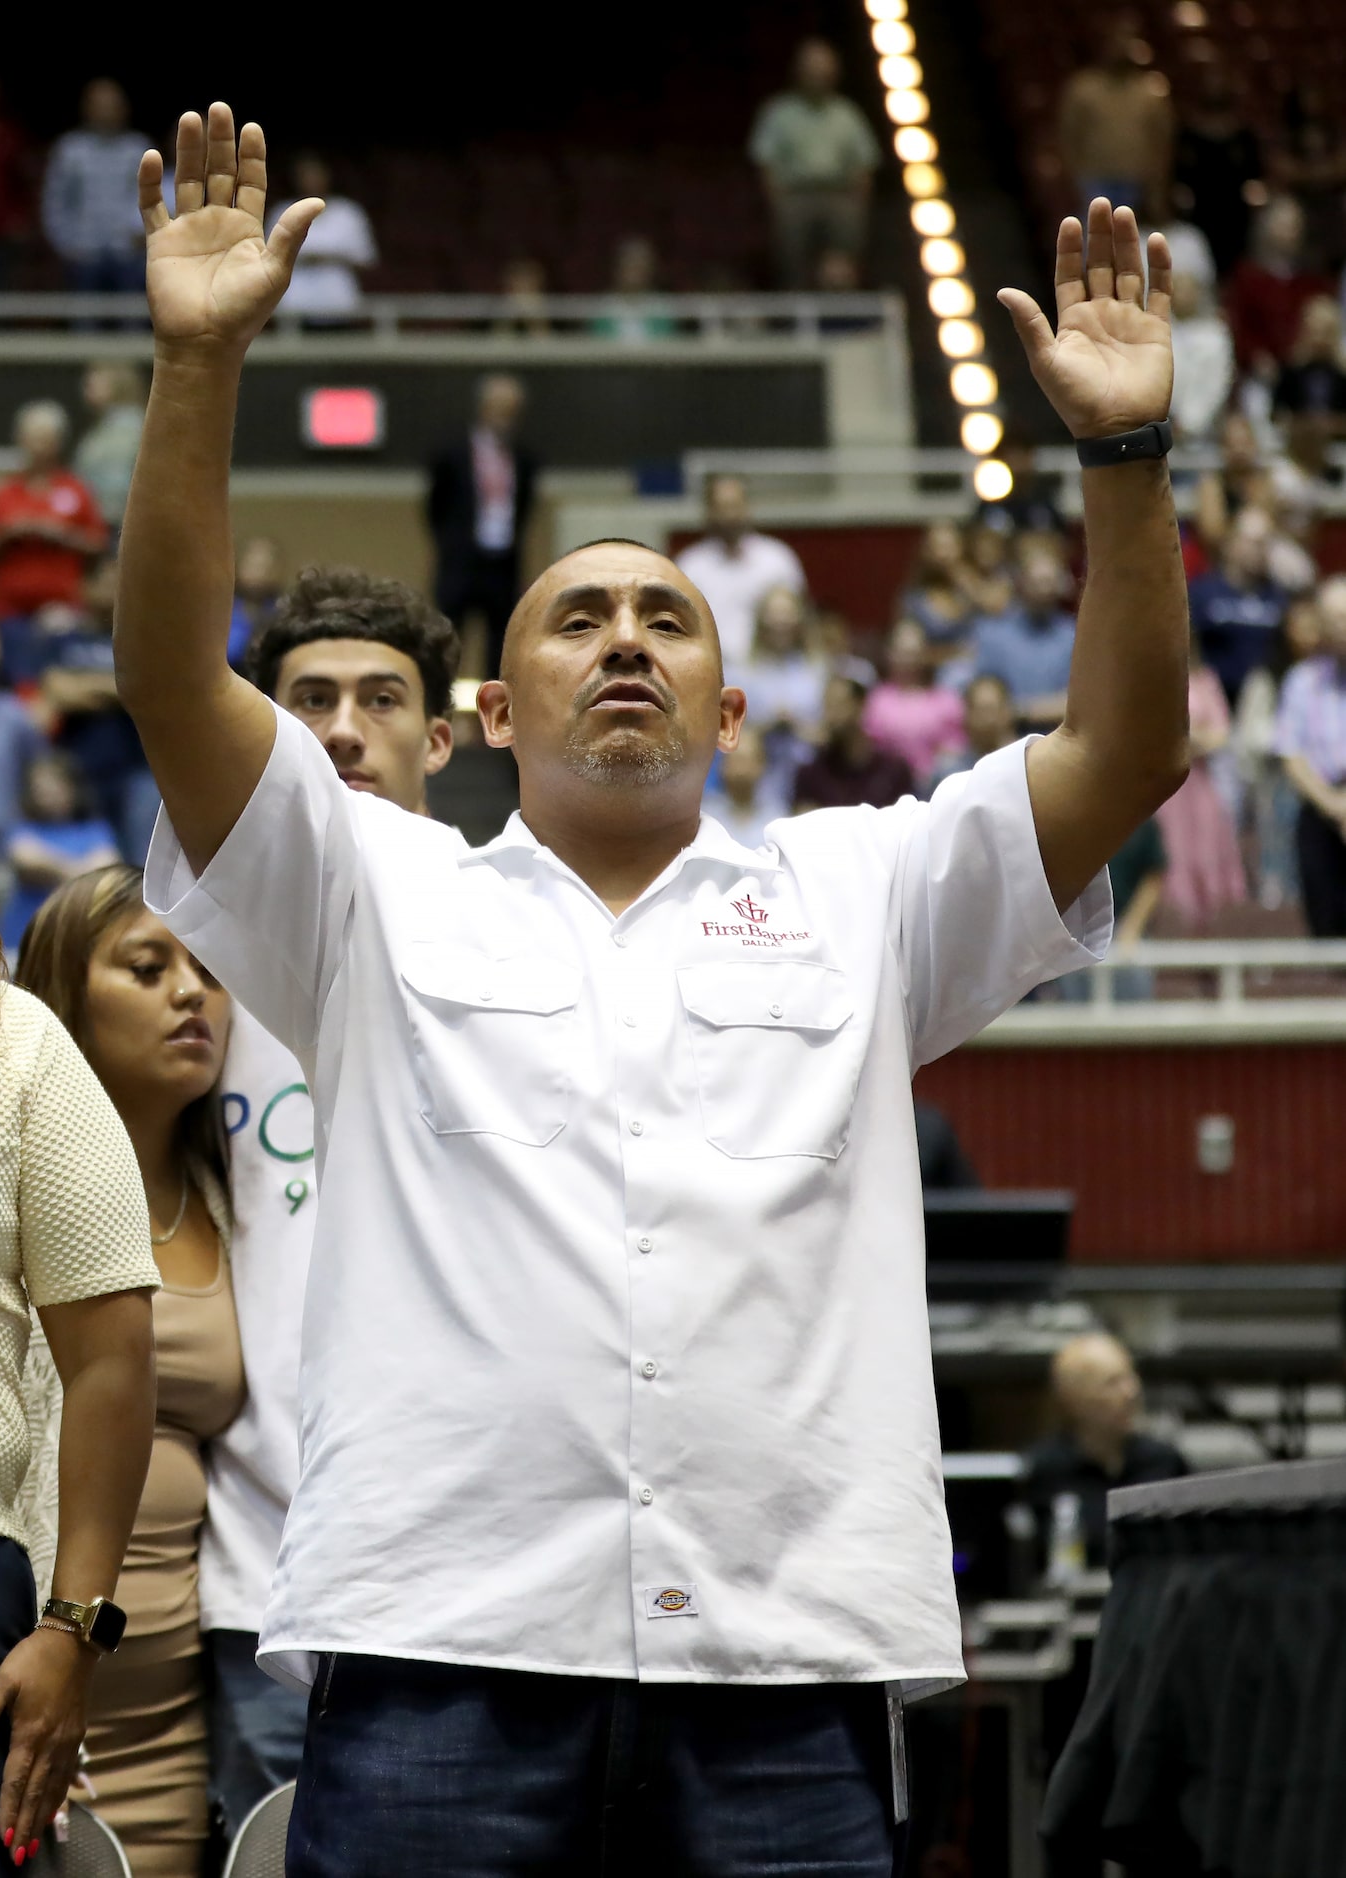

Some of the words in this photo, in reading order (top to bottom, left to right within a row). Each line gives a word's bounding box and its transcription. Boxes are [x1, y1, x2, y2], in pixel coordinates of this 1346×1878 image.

[701, 921, 746, 937] First
[746, 923, 813, 942] Baptist
[741, 939, 783, 948] DALLAS
[655, 1596, 690, 1605] Dickies
